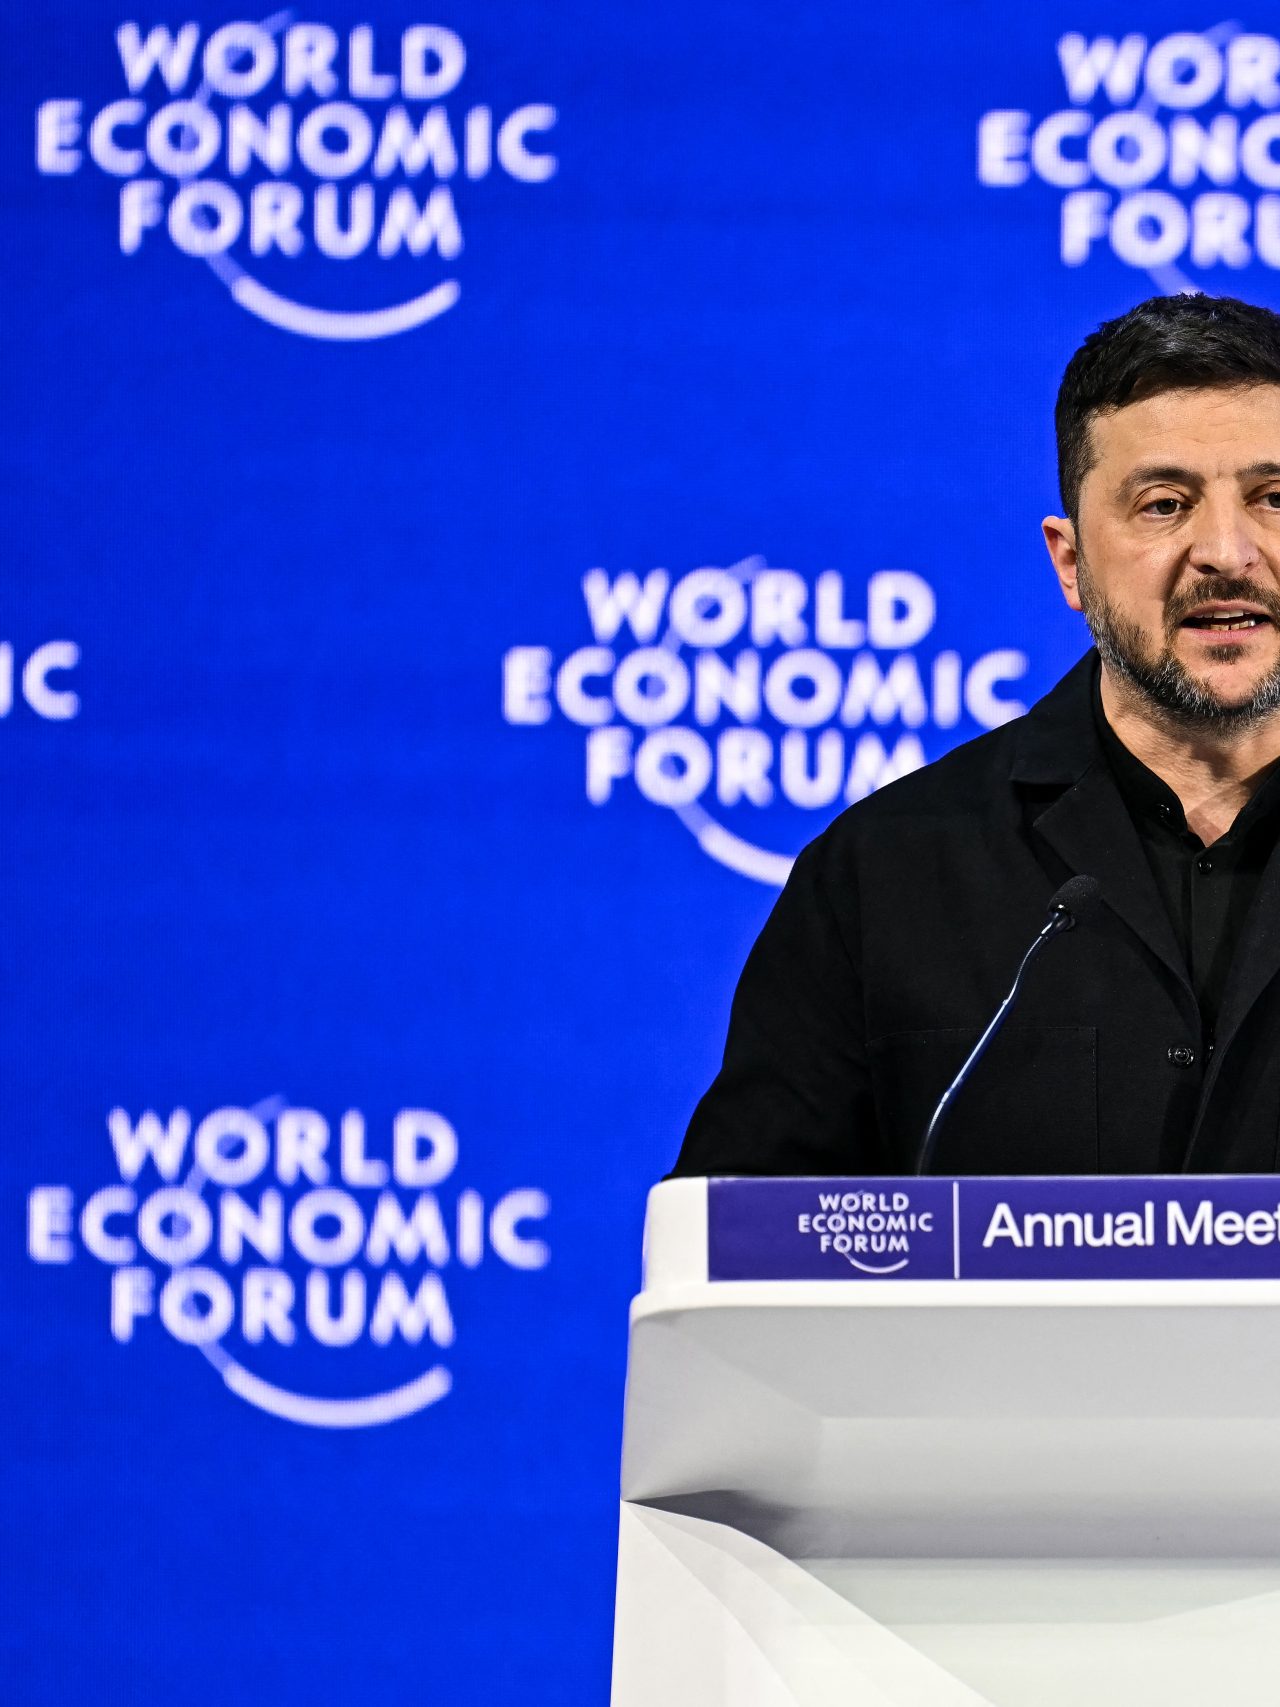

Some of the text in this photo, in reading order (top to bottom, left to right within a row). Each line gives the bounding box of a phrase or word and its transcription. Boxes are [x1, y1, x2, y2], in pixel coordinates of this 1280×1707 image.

[115, 22, 468, 99] WORLD
[36, 99, 557, 183] ECONOMIC
[119, 179, 463, 265] FORUM
[582, 567, 937, 650] WORLD
[503, 646, 1029, 731] ECONOMIC
[107, 1108, 460, 1189] WORLD
[28, 1185, 550, 1270] ECONOMIC
[798, 1212, 934, 1233] ECONOMIC
[819, 1192, 910, 1213] WORLD
[820, 1233, 910, 1254] FORUM
[982, 1200, 1155, 1248] Annual
[110, 1266, 455, 1349] FORUM
